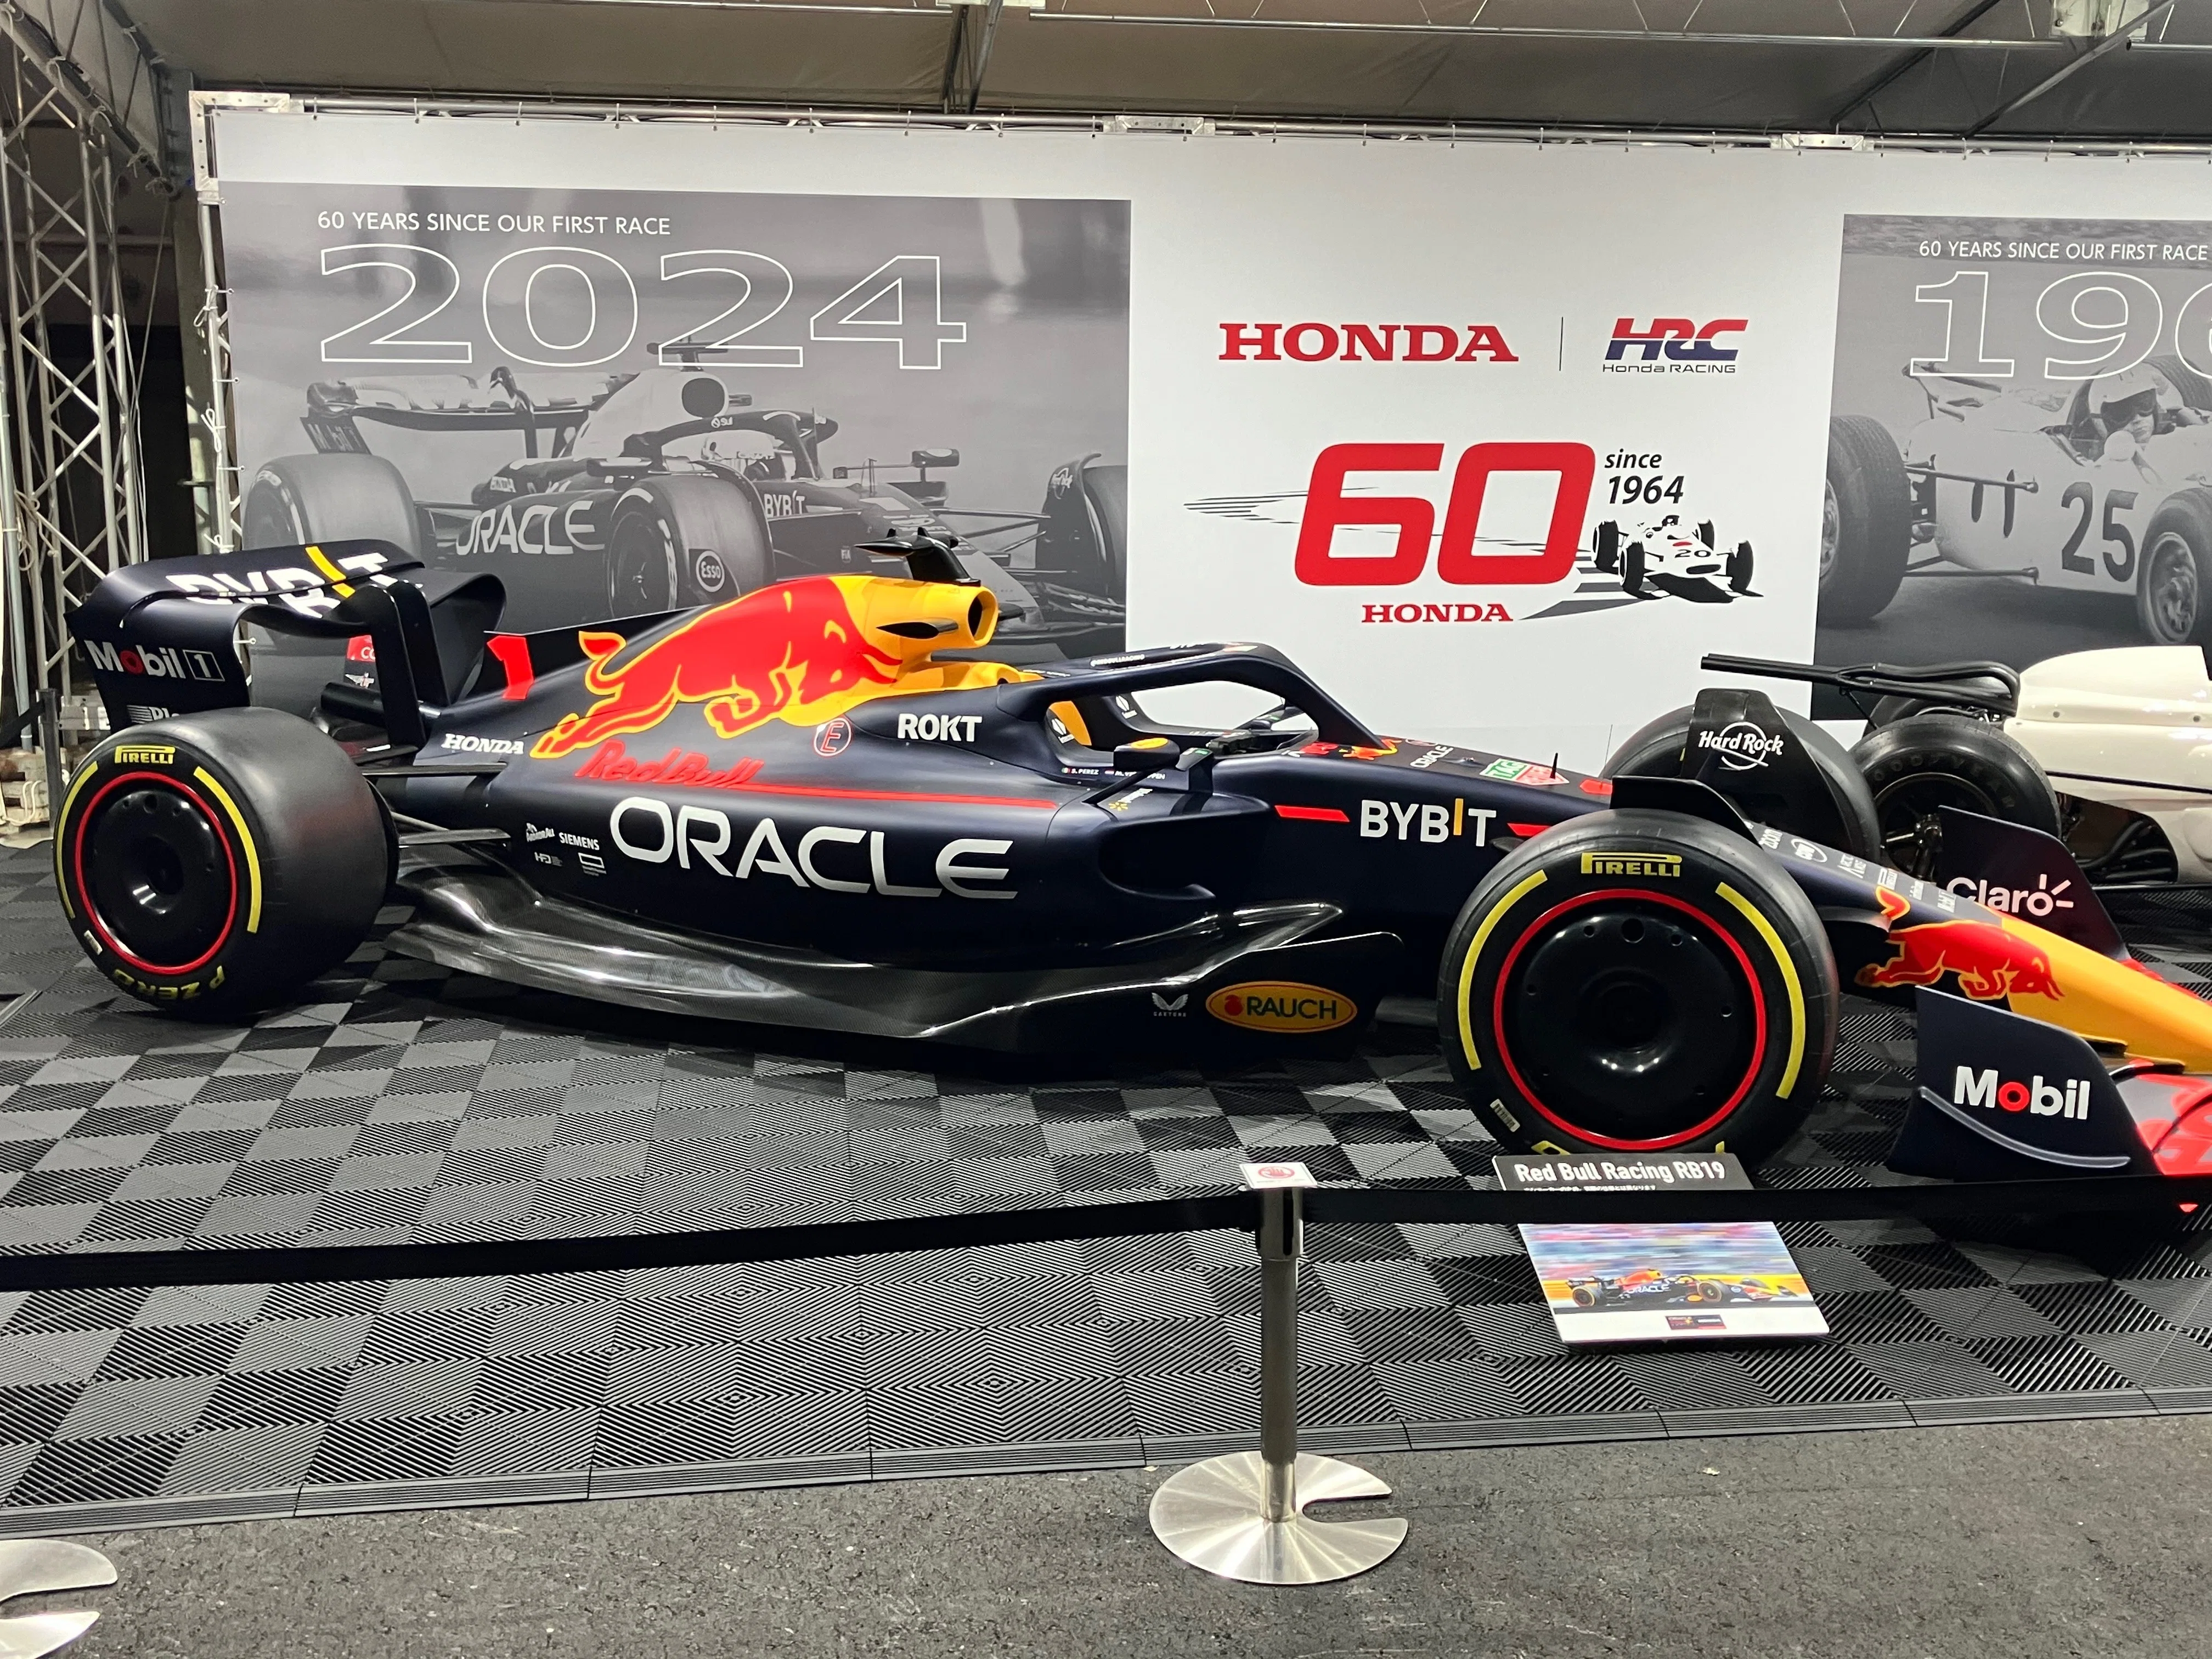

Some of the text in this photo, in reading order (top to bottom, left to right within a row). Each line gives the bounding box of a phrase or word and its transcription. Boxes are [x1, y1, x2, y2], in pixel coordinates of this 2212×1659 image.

[318, 211, 670, 235] 60 YEARS SINCE OUR FIRST RACE
[1920, 240, 2208, 261] 60 YEARS SINCE OUR FIRST RACE
[320, 243, 967, 370] 2024
[1220, 323, 1518, 362] HONDA
[1605, 318, 1748, 360] HRC
[1602, 364, 1736, 373] Honda RACING
[1604, 448, 1662, 469] since
[1607, 475, 1684, 504] 1964
[1295, 442, 1595, 586] 60
[2061, 482, 2138, 582] 25
[1675, 548, 1711, 557] 20
[701, 561, 721, 579] Esso
[1364, 603, 1513, 623] HONDA
[84, 640, 211, 679] Mobil 1
[487, 635, 534, 699] 1
[898, 713, 983, 742] ROKT
[114, 745, 176, 764] PIRELLI
[441, 733, 524, 755] HONDA
[1698, 731, 1784, 755] Hard Rock
[1360, 798, 1496, 847] BYBIT
[558, 832, 600, 850] SIEMENS
[610, 797, 1018, 899] ORACLE
[1581, 852, 1682, 877] PIRELLI
[1946, 876, 2053, 916] Claro
[1246, 996, 1337, 1020] RAUCH
[1954, 1066, 2090, 1120] Mobil
[1514, 1161, 1725, 1183] Red Bull Racing RB19
